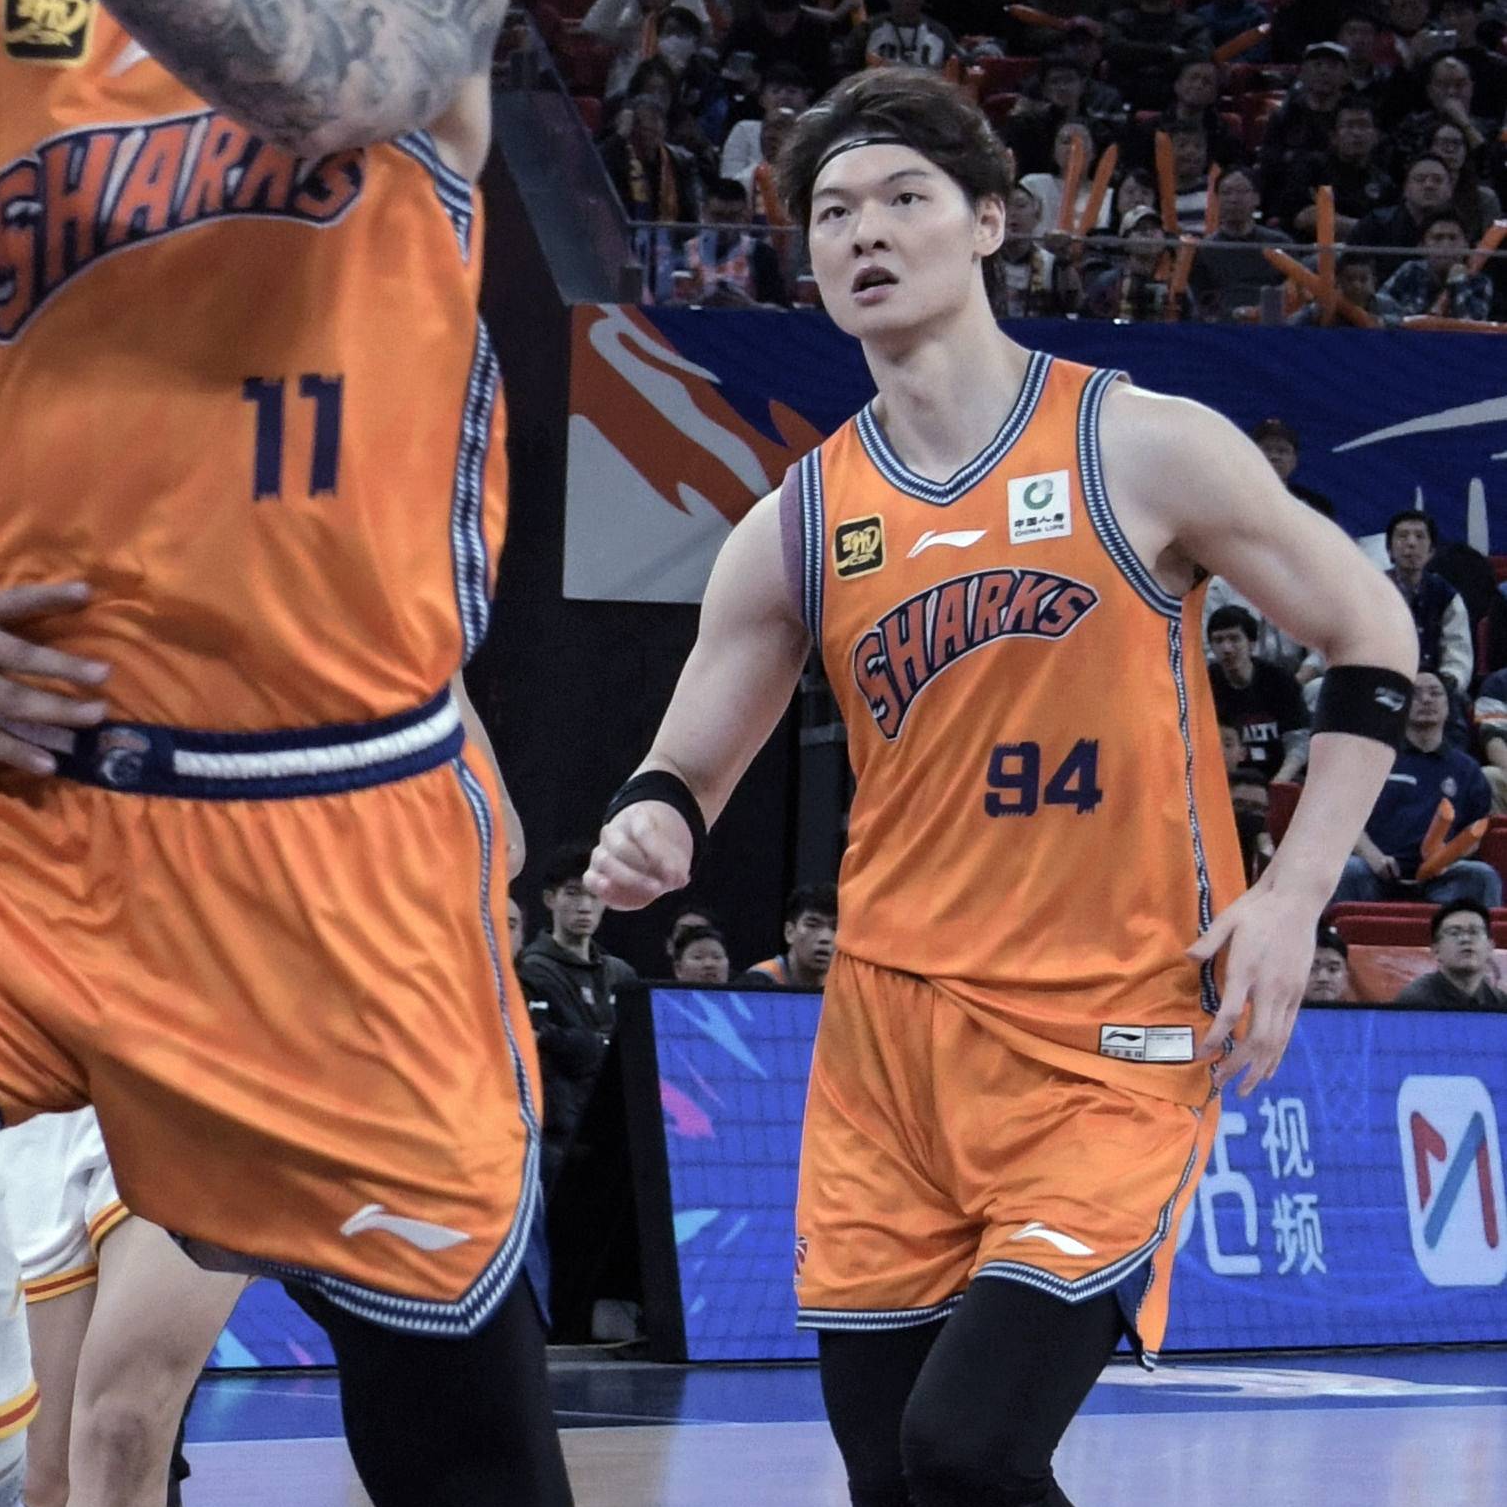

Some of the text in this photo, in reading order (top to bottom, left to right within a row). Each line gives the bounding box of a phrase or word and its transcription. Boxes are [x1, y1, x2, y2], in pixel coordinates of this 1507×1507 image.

[241, 372, 345, 502] 11
[852, 566, 1102, 743] SHARKS
[983, 737, 1104, 820] 94
